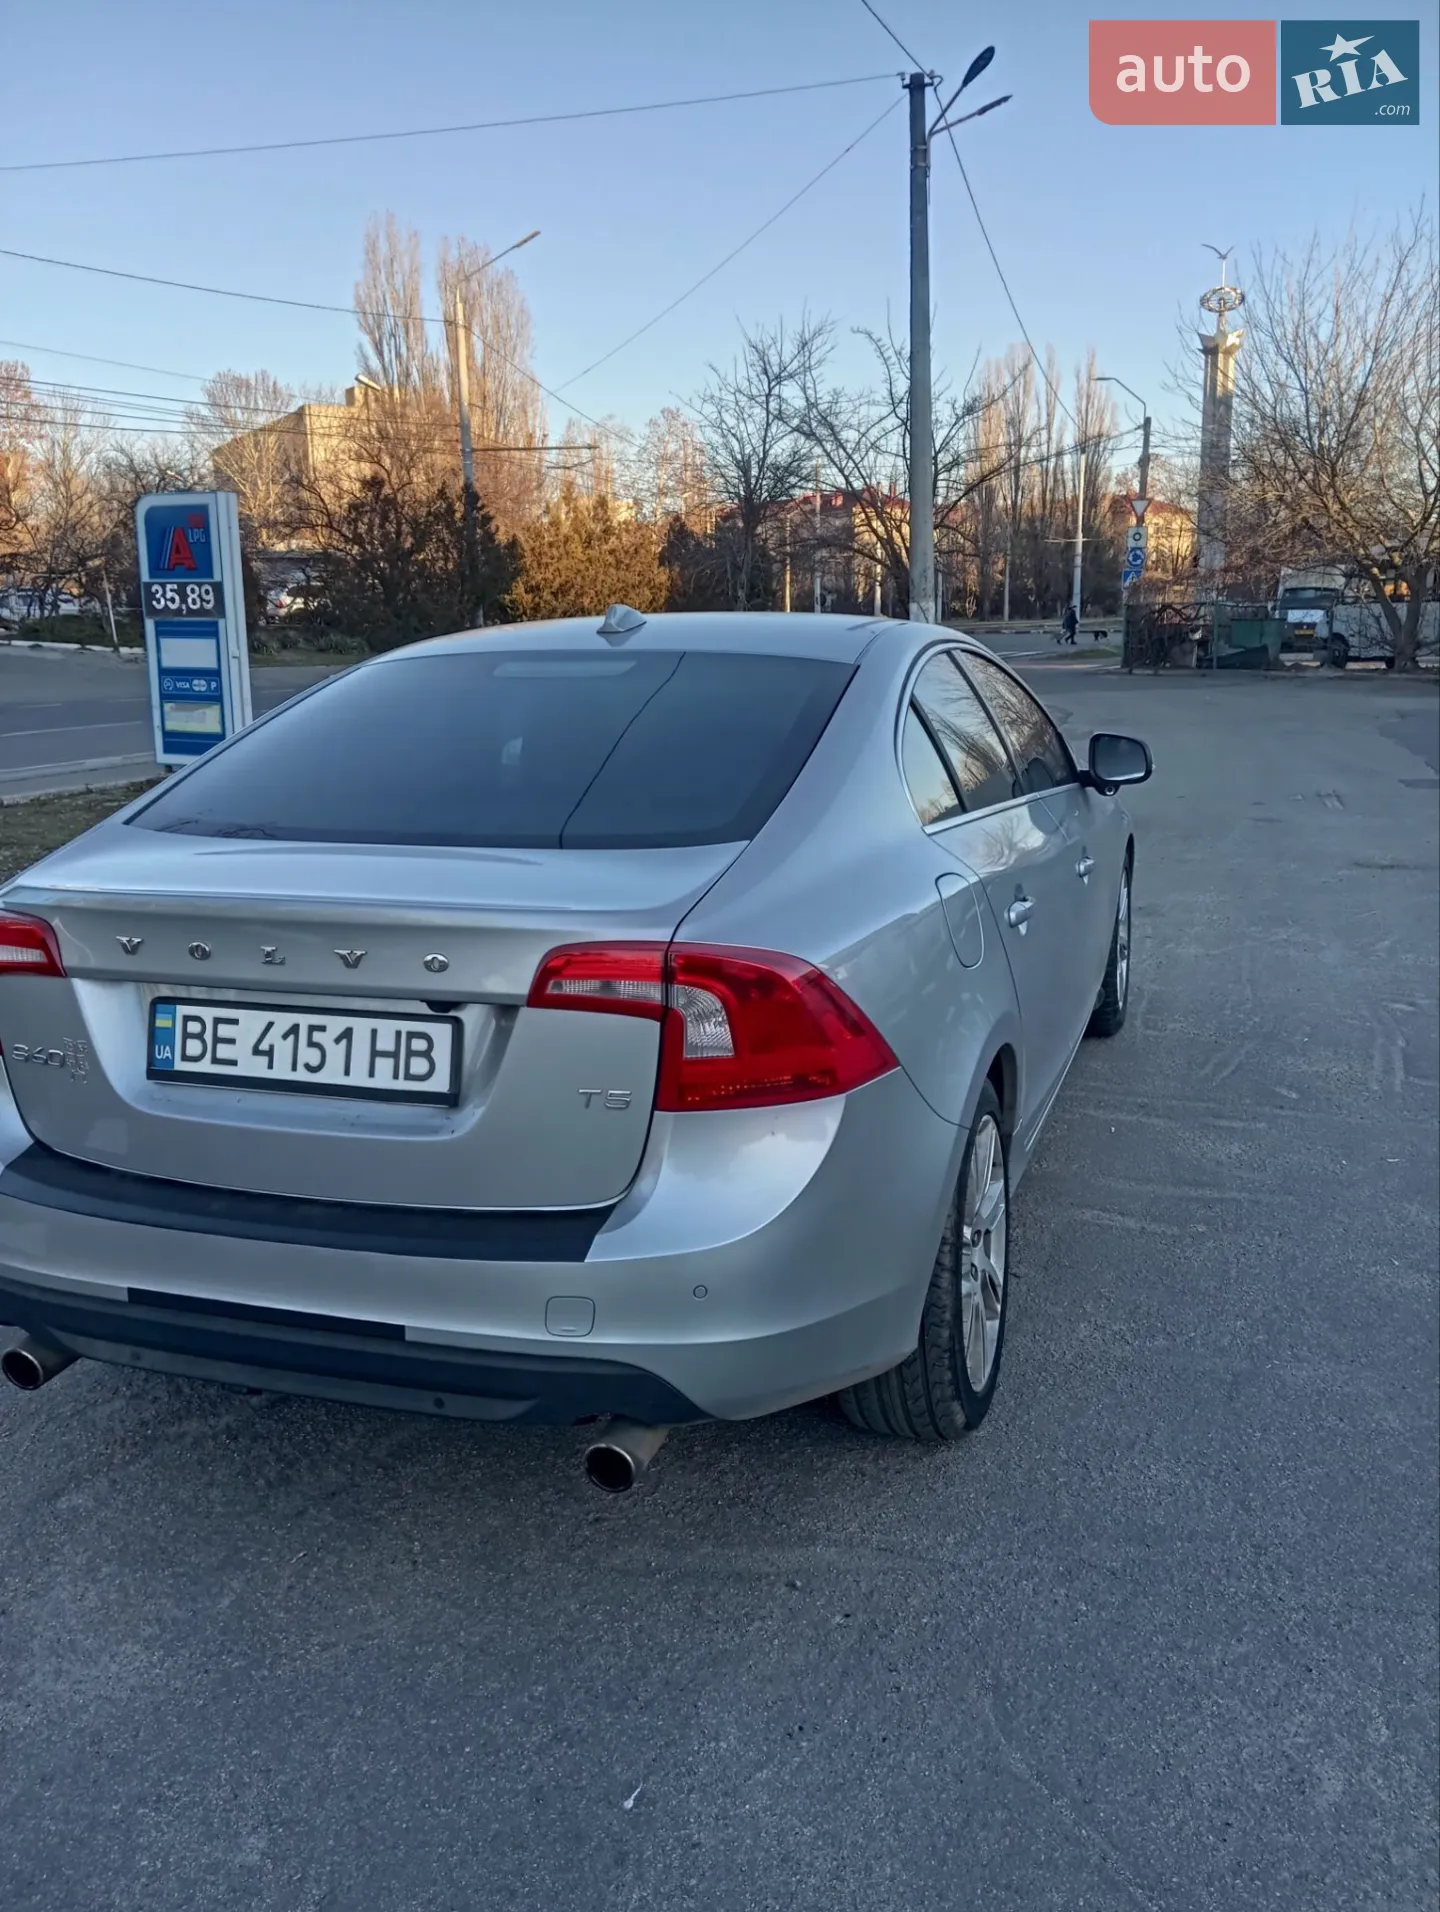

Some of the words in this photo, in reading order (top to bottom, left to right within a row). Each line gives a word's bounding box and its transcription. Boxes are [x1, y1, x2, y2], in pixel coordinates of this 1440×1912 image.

[188, 528, 206, 543] LPG
[151, 583, 215, 615] 35,89
[115, 935, 450, 974] VOLVO
[12, 1043, 65, 1067] S60
[154, 1046, 172, 1061] UA
[180, 1014, 240, 1067] BE
[251, 1020, 354, 1077] 4151
[368, 1028, 437, 1083] HB
[578, 1088, 631, 1109] T5
